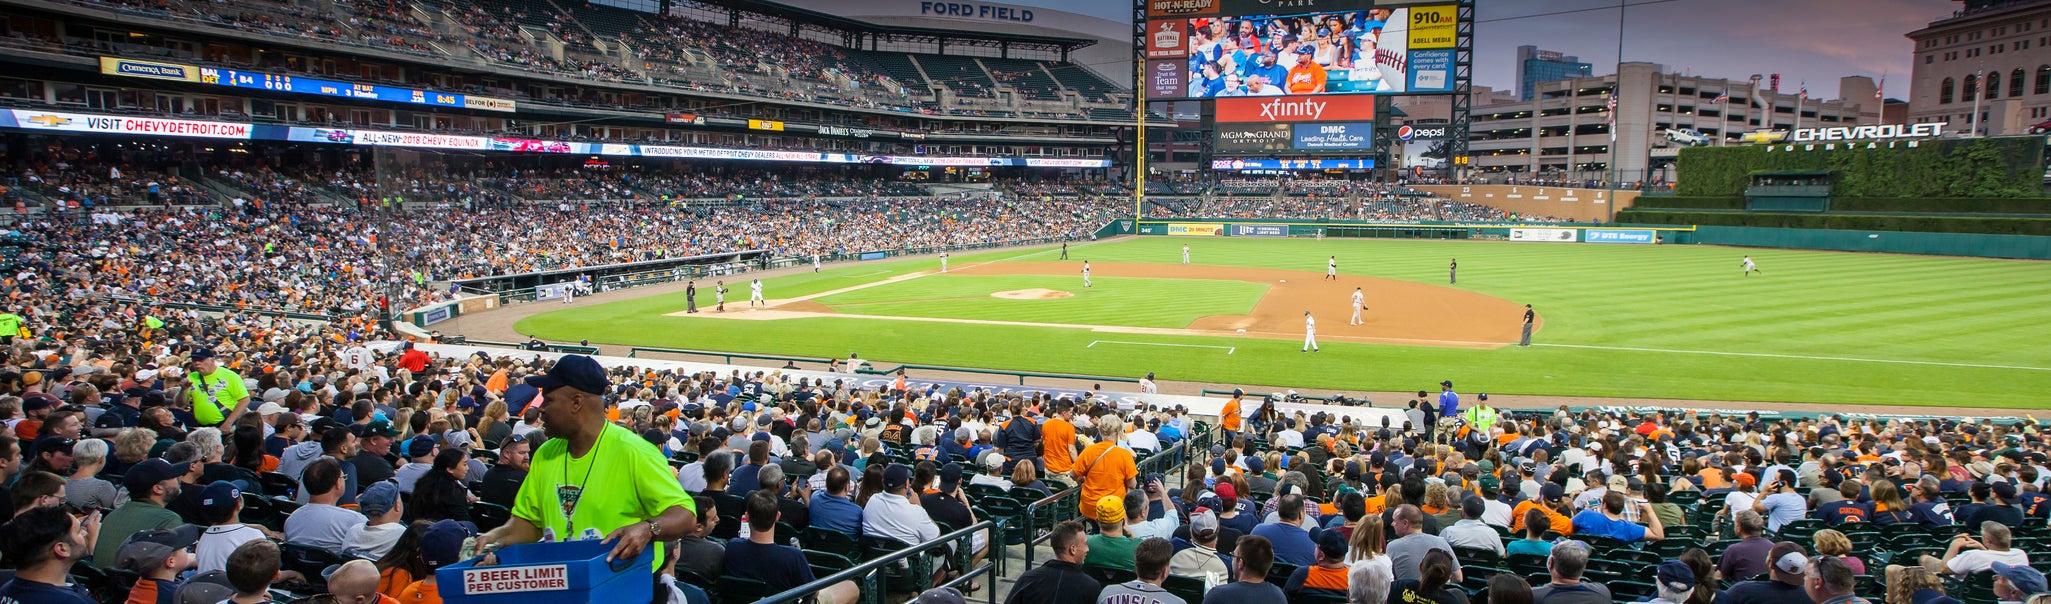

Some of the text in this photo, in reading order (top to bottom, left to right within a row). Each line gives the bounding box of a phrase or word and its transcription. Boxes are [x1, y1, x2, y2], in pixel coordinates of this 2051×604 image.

[1154, 0, 1213, 10] HOT-N-READY
[921, 2, 1034, 23] FORD FIELD
[1414, 11, 1440, 24] 910
[161, 67, 181, 76] Bank
[200, 67, 236, 79] BAL 7
[201, 76, 237, 86] DET 4
[240, 75, 253, 84] B4
[1155, 76, 1178, 85] Team
[265, 81, 292, 91] 0 0 0
[321, 86, 337, 94] MPH
[345, 89, 351, 97] 3
[436, 95, 455, 104] 8:45
[465, 98, 485, 106] BELFOR
[1260, 97, 1327, 120] xfinity
[87, 117, 245, 136] VISIT CHEVYDETROIT.COM
[1321, 125, 1346, 134] DMC
[1220, 131, 1242, 139] MGM
[1414, 127, 1445, 138] pepsi
[1793, 122, 1948, 142] CHEVROLET
[363, 133, 479, 147] ALL-NEW 2018 CHEVY EQUINOX
[1766, 140, 1919, 152] FOUNTAIN
[644, 147, 682, 155] INTRODUCING
[683, 148, 697, 156] YOUR
[698, 149, 717, 157] METRO
[717, 150, 738, 158] DETROIT
[738, 150, 755, 158] CHEVY
[755, 151, 775, 159] DEALERS
[1240, 225, 1254, 235] Lite
[1601, 232, 1649, 241] DTE Energy
[351, 354, 359, 364] 6
[467, 567, 565, 583] 2 BEER LIMIT
[468, 579, 565, 593] PER CUSTOMER
